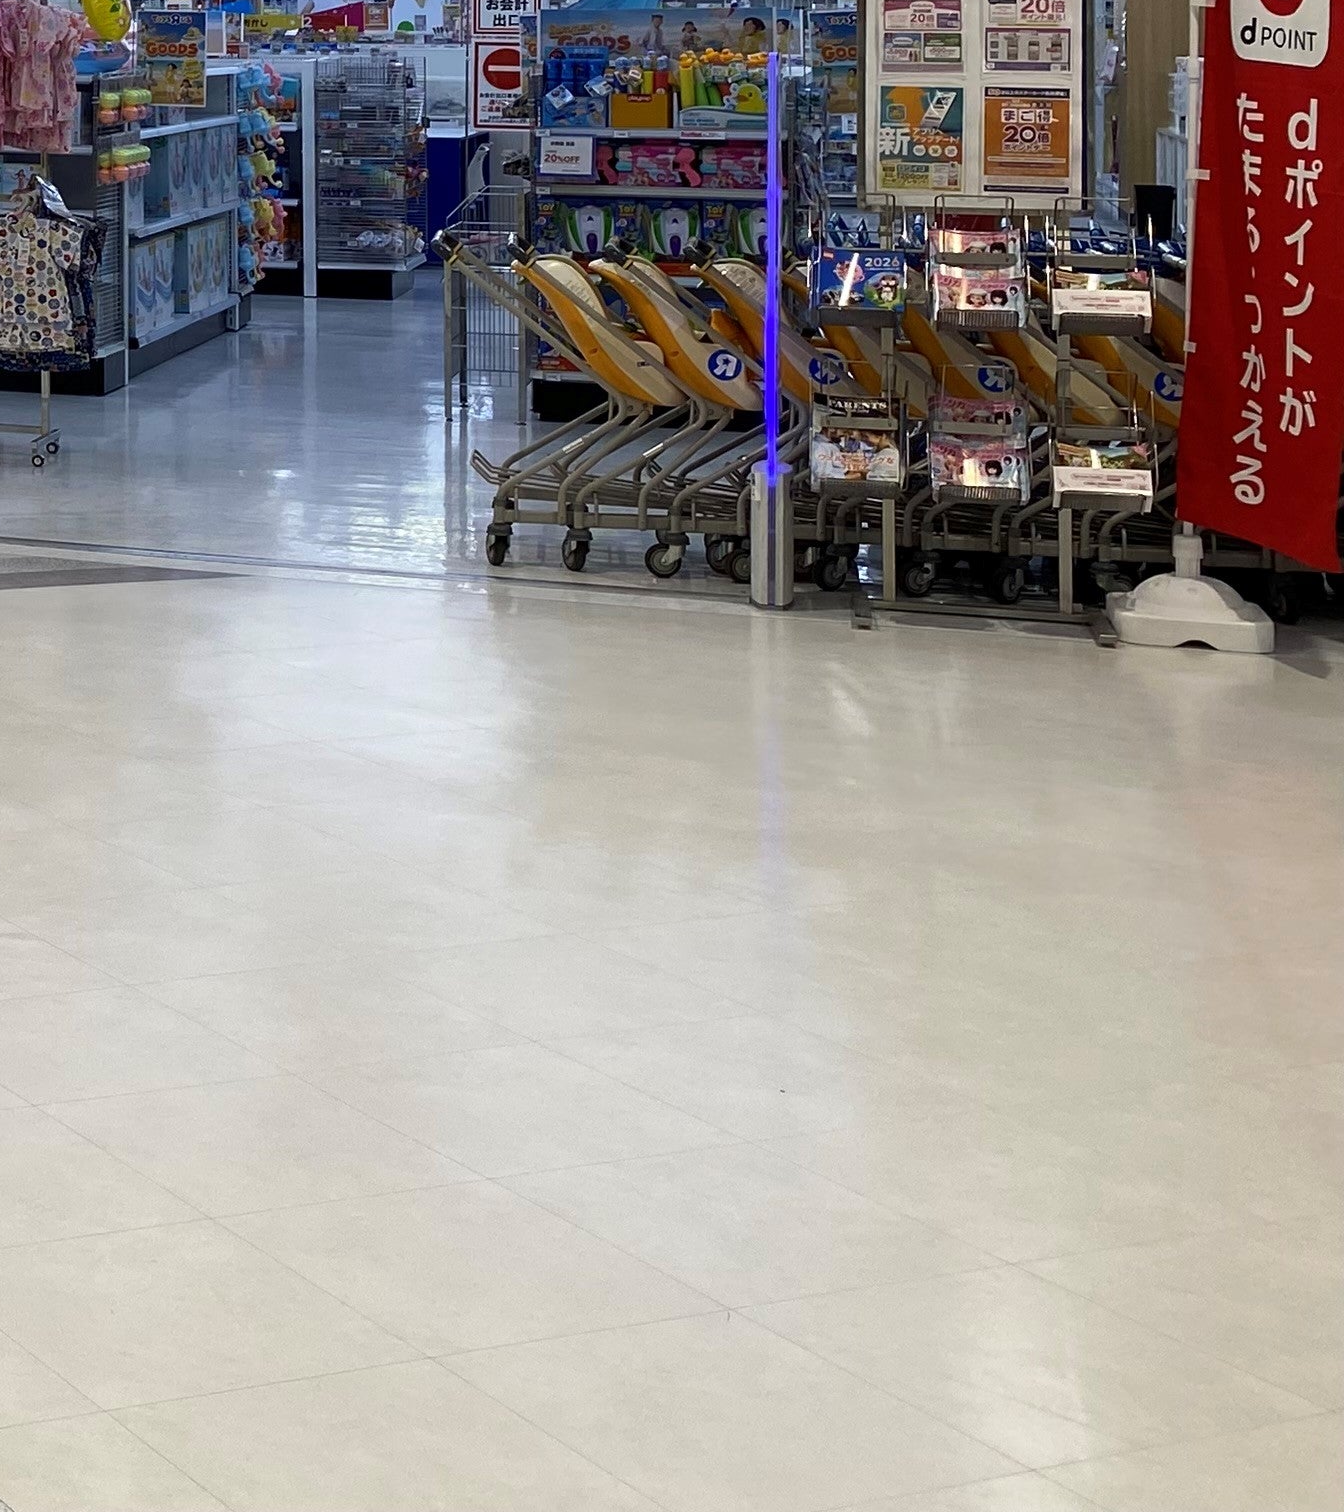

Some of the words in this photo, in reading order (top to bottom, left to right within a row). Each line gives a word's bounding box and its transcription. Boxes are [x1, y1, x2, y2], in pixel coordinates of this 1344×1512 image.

[493, 15, 519, 27] 出口
[1262, 27, 1317, 52] POINT
[146, 42, 198, 56] GOODS
[822, 44, 857, 62] GOO
[1001, 109, 1052, 123] まご得
[880, 127, 910, 154] 新
[1003, 126, 1050, 143] 20倍
[544, 154, 580, 165] 20%OFF
[865, 257, 900, 268] 2026
[1279, 98, 1323, 436] dポイントが
[829, 399, 887, 410] PARENTS
